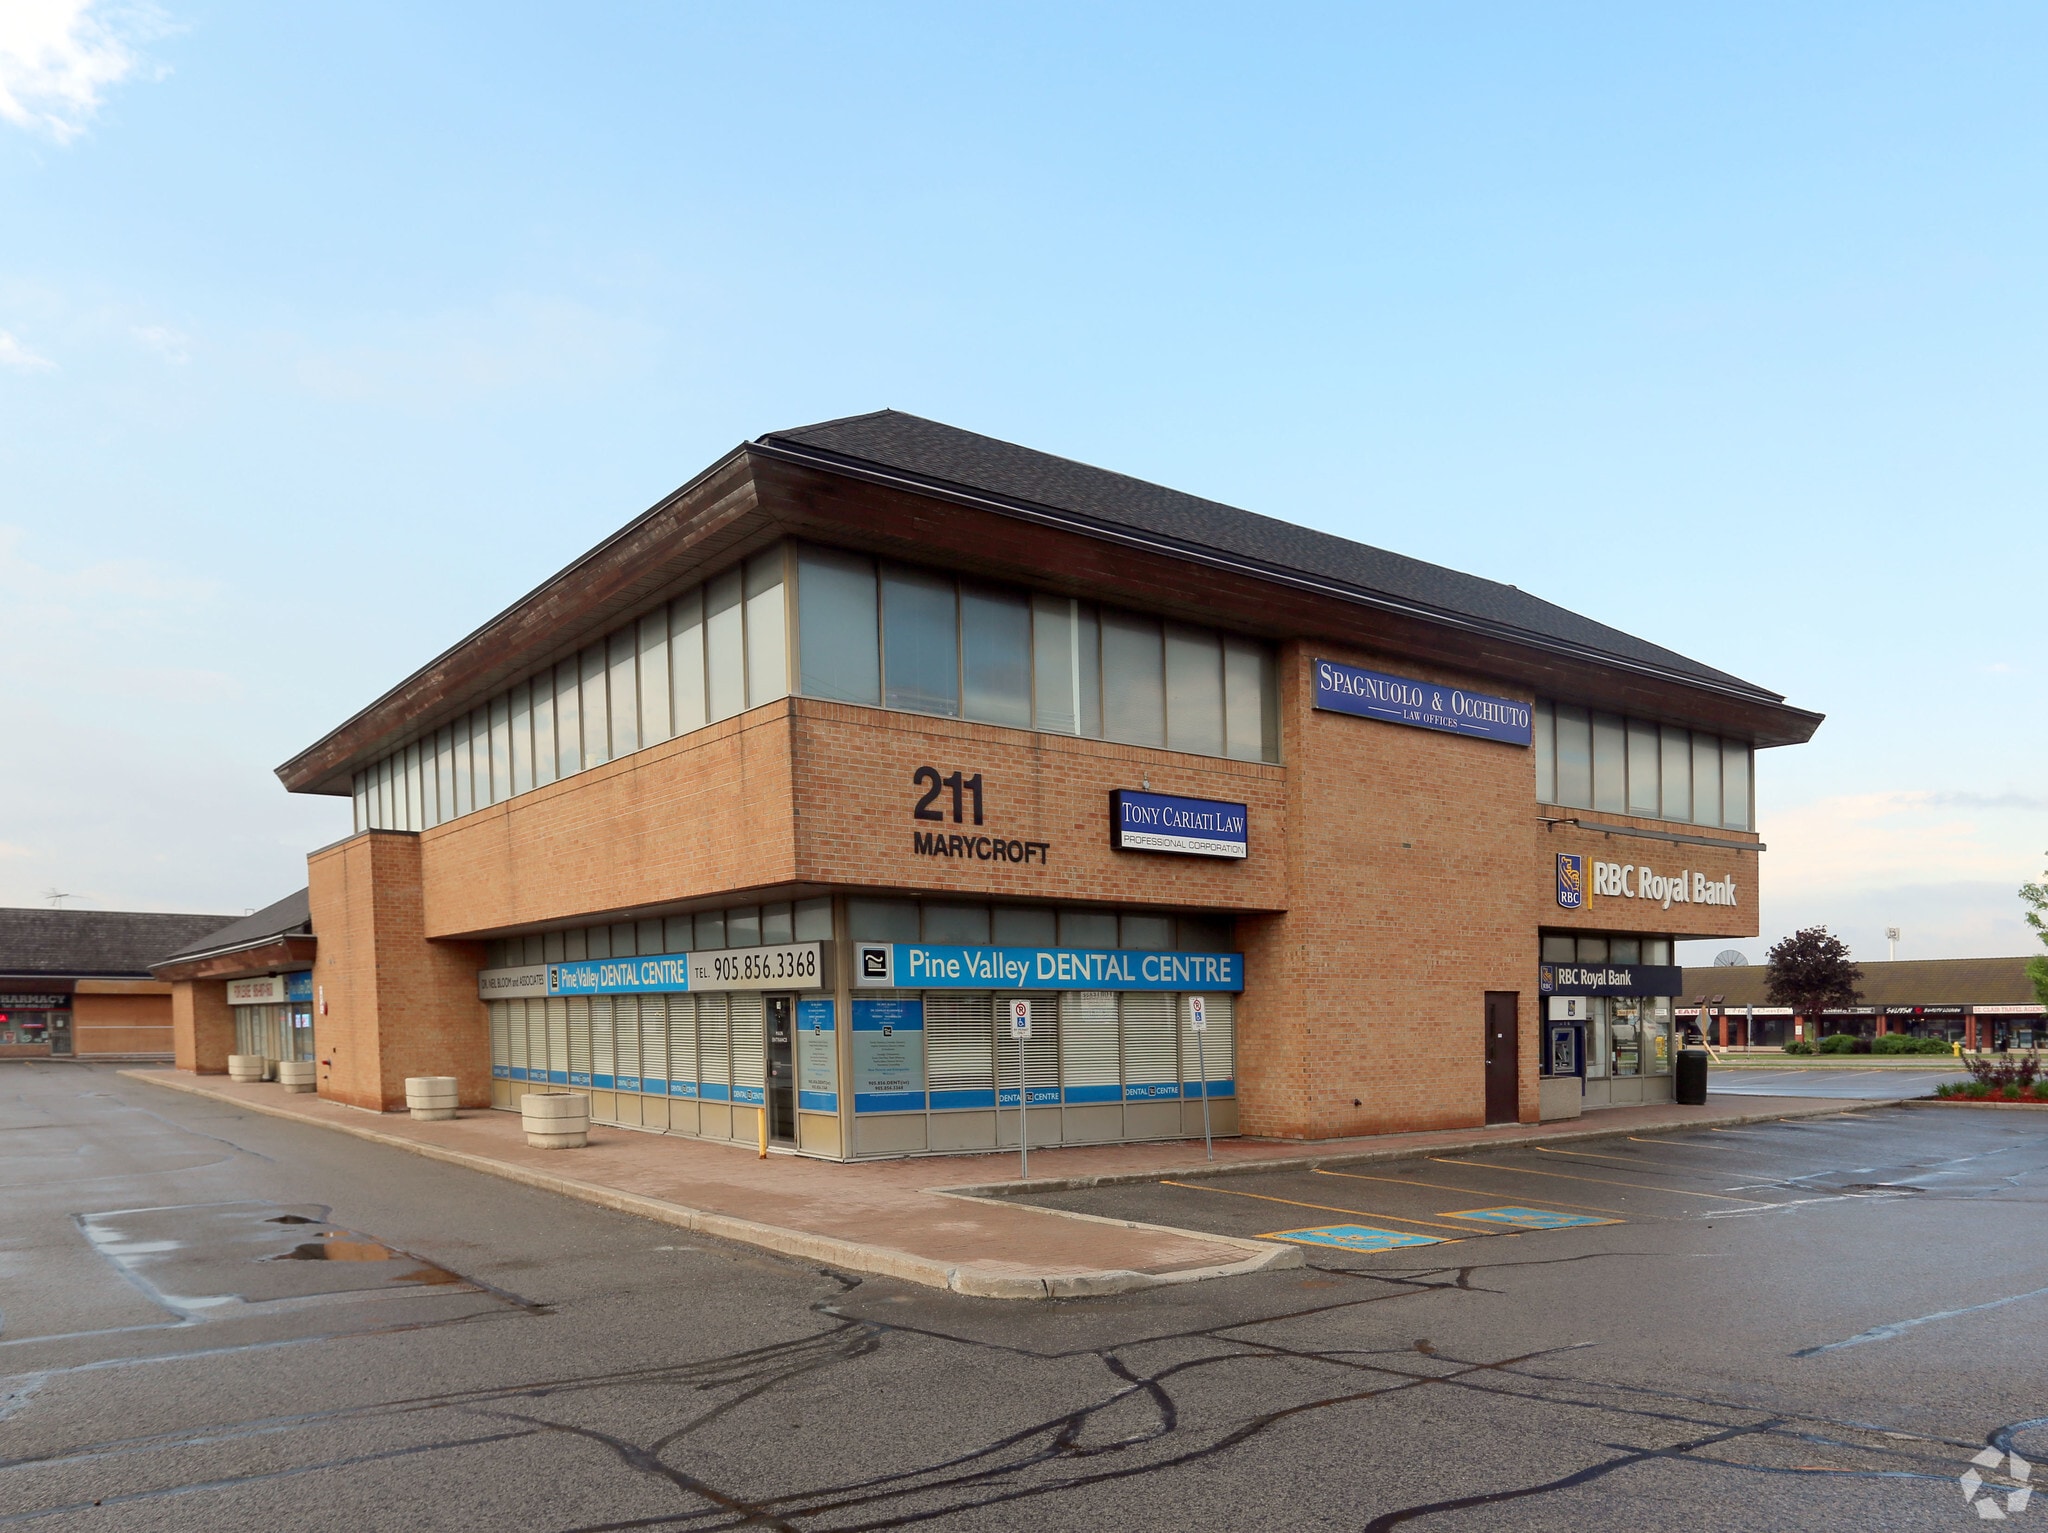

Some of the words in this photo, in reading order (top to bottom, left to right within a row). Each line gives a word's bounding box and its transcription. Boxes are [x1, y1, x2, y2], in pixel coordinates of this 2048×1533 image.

[1320, 664, 1423, 707] SPAGNUOLO
[1431, 691, 1443, 712] &
[1451, 690, 1529, 728] OCCHIUTO
[1403, 709, 1421, 721] LAW
[1423, 714, 1458, 728] OFFICES
[913, 765, 983, 826] 211
[1122, 802, 1160, 825] TONY
[1162, 806, 1213, 831] CARIATI
[1216, 812, 1244, 834] LAW
[914, 831, 1050, 865] MARYCROFT
[1123, 834, 1186, 849] PROFESSIONAL
[1188, 840, 1244, 854] CORPORATION
[1561, 891, 1579, 904] RBC
[1593, 861, 1635, 898] RBC
[1638, 866, 1690, 910] Royal
[1692, 872, 1737, 906] Bank
[561, 968, 577, 988] Pine
[577, 965, 599, 993] Valley
[600, 963, 639, 987] DENTAL
[640, 959, 685, 985] CENTRE
[695, 967, 711, 979] TEL.
[714, 950, 816, 981] 905.856.3368
[909, 949, 960, 979] Pine
[963, 951, 1030, 987] Valley
[1036, 952, 1136, 982] DENTAL
[1141, 954, 1231, 983] CENTRE
[1558, 968, 1578, 985] RBC
[1580, 968, 1606, 989] Royal
[1608, 969, 1632, 986] Bank
[497, 976, 511, 989] BLOOM
[519, 974, 544, 987] ASSOCIATES
[0, 994, 66, 1004] HARMACY
[999, 1094, 1021, 1103] DENTA
[1034, 1092, 1059, 1101] CENTRE
[1125, 1086, 1148, 1096] DENTAL
[1155, 1085, 1178, 1095] CENTRE
